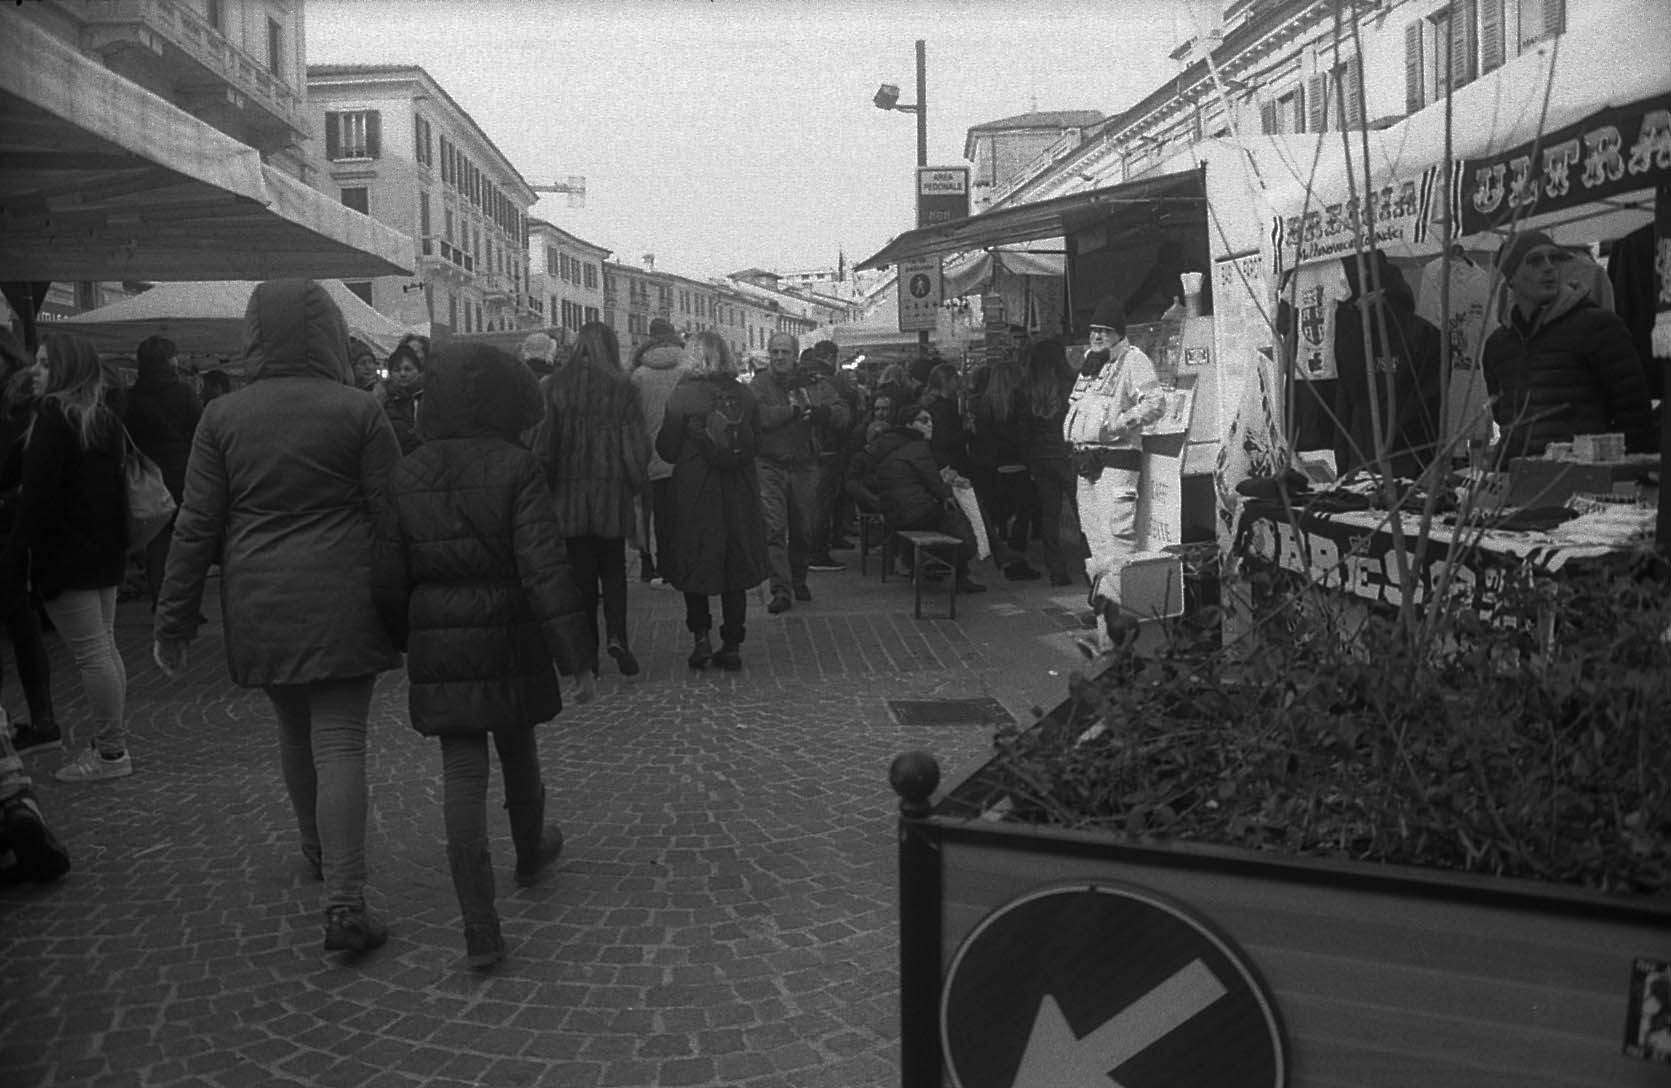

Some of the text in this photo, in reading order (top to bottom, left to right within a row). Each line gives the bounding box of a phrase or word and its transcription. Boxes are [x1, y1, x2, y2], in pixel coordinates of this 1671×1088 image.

[1473, 109, 1671, 214] ULTRA
[934, 173, 953, 181] AREA
[923, 182, 963, 191] PEDONALE
